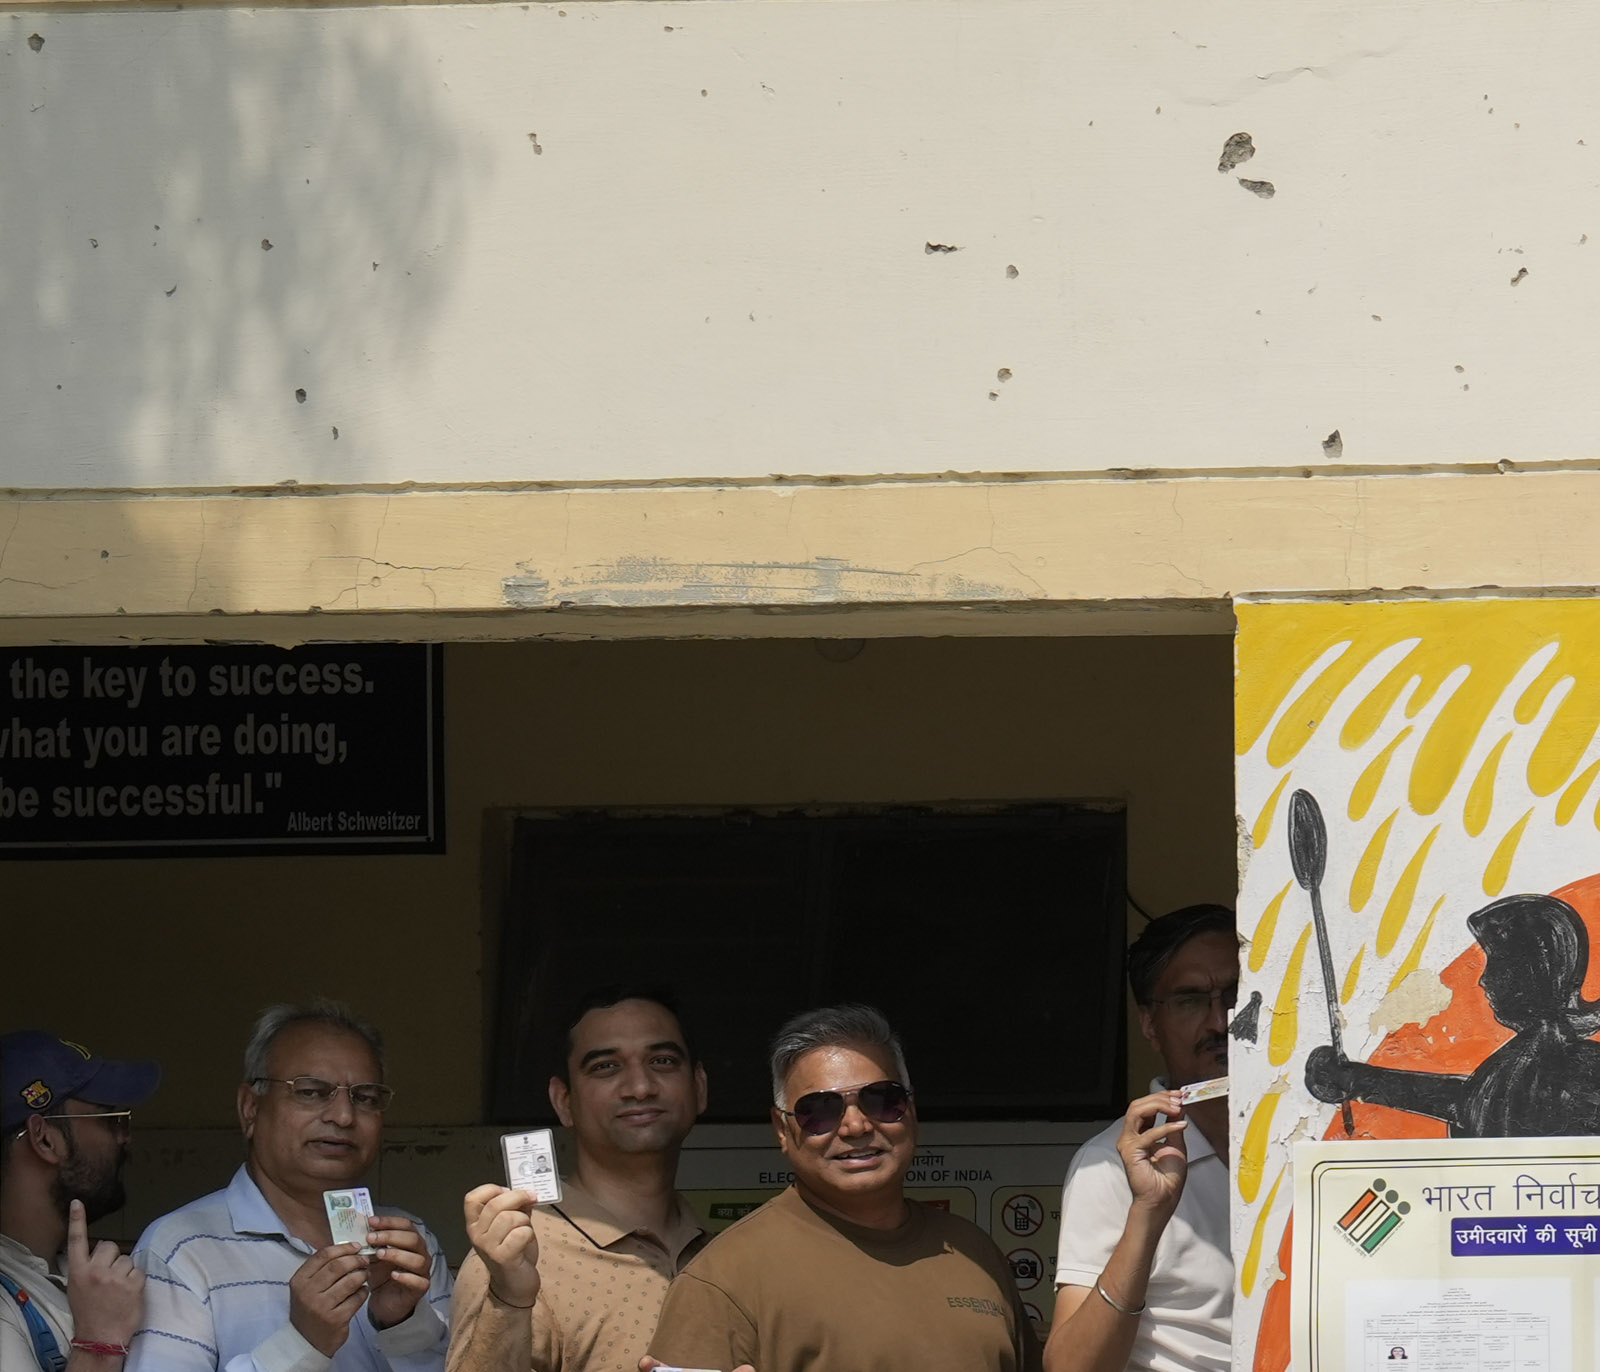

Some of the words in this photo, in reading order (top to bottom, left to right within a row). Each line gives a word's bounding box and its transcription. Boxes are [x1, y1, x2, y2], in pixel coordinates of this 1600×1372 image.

[9, 656, 70, 699] the
[83, 656, 148, 708] key
[160, 656, 197, 697] to
[208, 661, 375, 697] success.
[83, 724, 148, 768] you
[160, 724, 221, 756] are
[234, 712, 349, 766] doing,
[52, 771, 282, 818] successful."
[287, 811, 335, 832] Albert
[338, 809, 421, 832] Schweitzer
[930, 1169, 951, 1182] OF
[954, 1169, 993, 1182] INDIA
[1421, 1184, 1497, 1212] भारत
[1455, 1222, 1528, 1245] उमीदवारों
[1535, 1222, 1557, 1244] की
[1564, 1222, 1598, 1248] सूची
